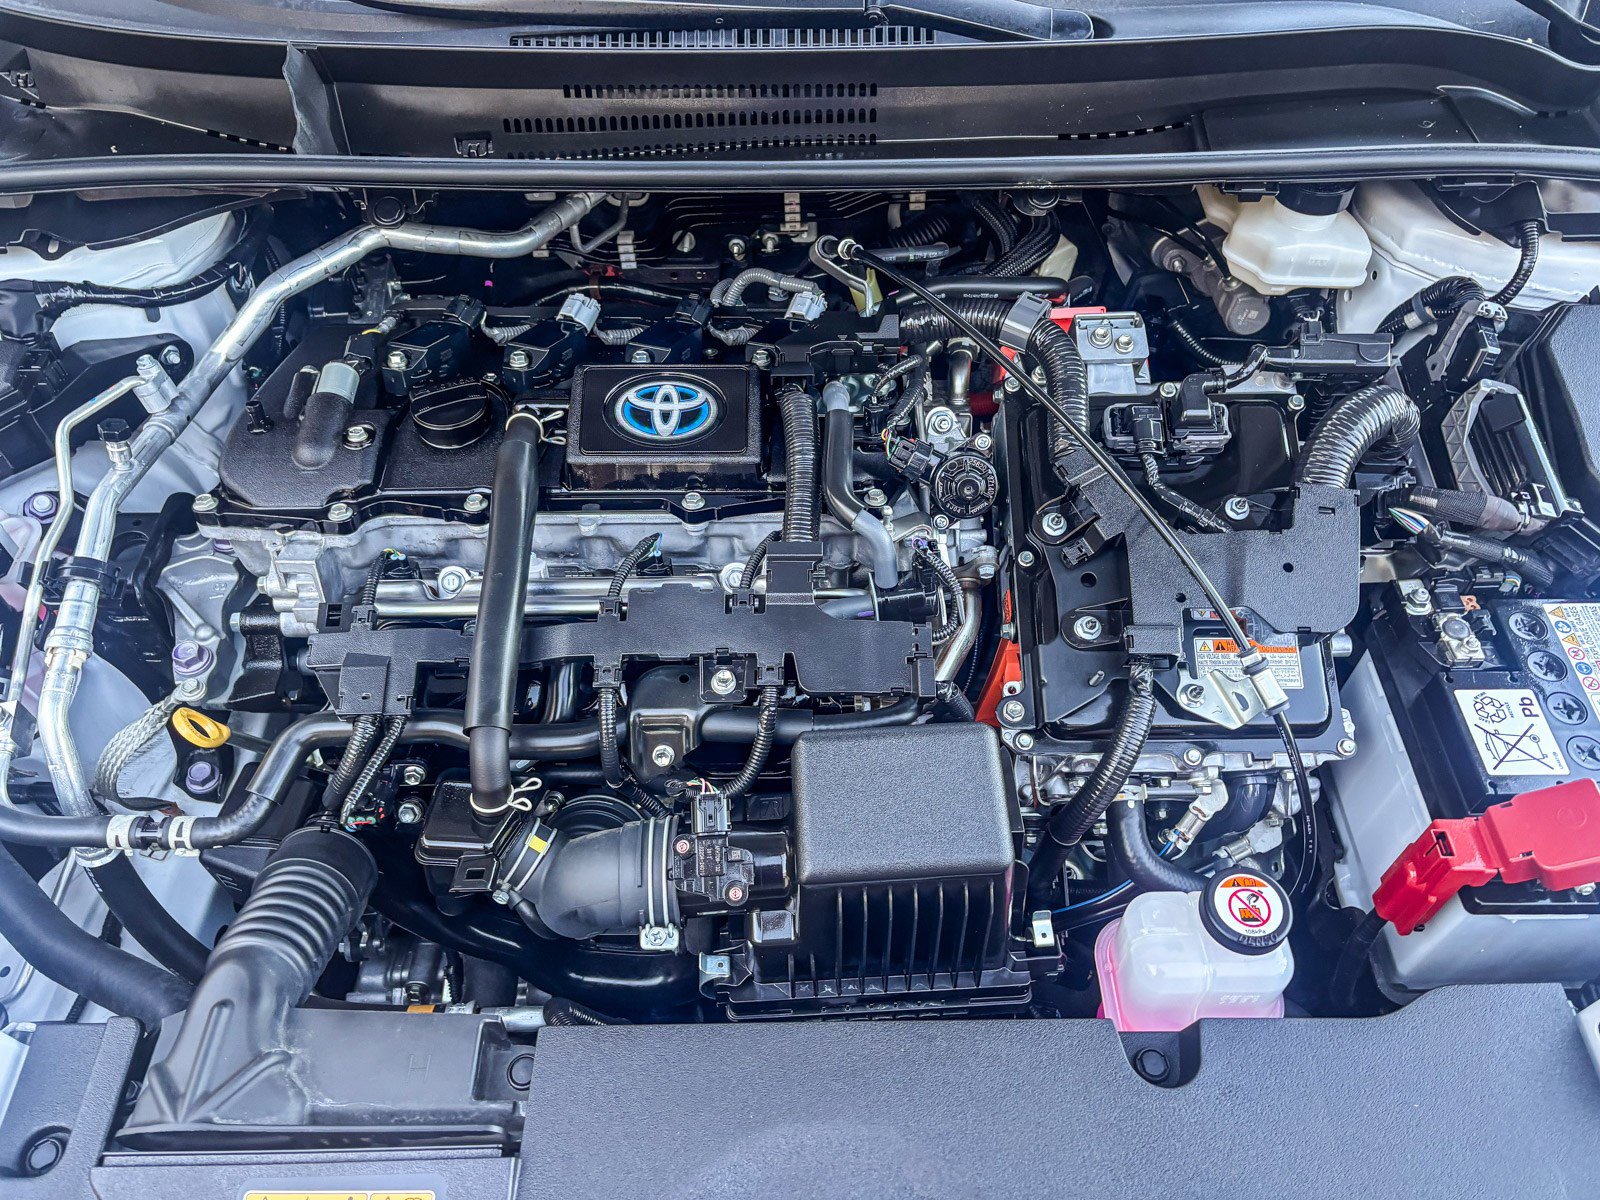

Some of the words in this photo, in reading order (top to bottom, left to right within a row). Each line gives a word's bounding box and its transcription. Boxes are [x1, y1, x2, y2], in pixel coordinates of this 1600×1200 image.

[1568, 606, 1585, 627] GASES
[1519, 696, 1540, 718] Pb
[1238, 934, 1278, 947] DENSO
